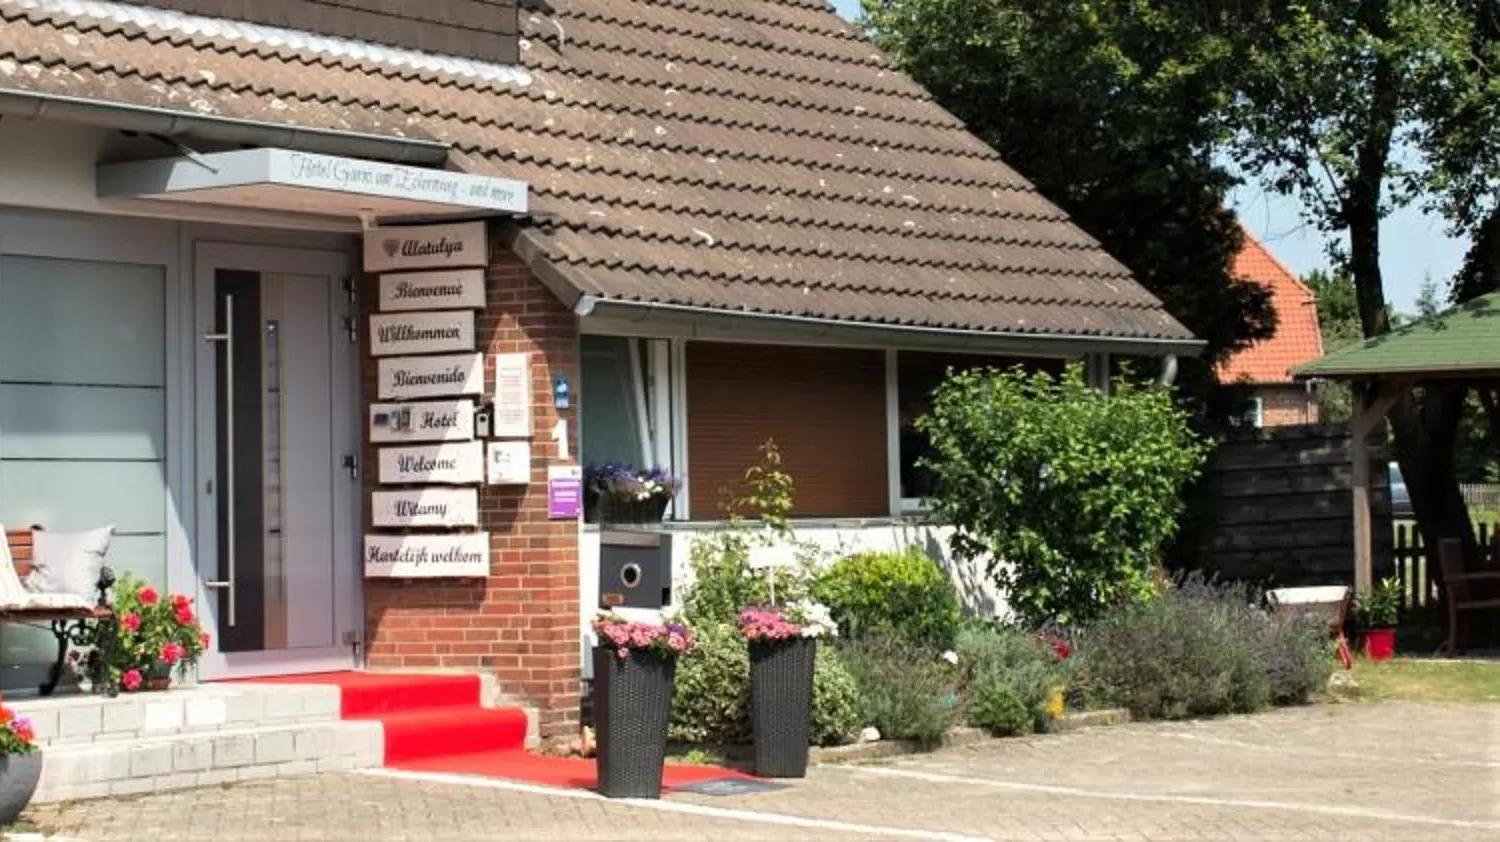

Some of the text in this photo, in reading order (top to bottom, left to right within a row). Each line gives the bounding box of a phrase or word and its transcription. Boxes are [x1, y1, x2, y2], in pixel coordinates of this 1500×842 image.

[377, 324, 460, 344] Willkommen
[392, 366, 465, 388] Bienvenido
[420, 411, 458, 430] Hotel
[551, 418, 569, 460] 1
[397, 454, 457, 473] Welcome
[394, 500, 448, 519] Witamy
[367, 545, 482, 568] Hartelijk welkom
